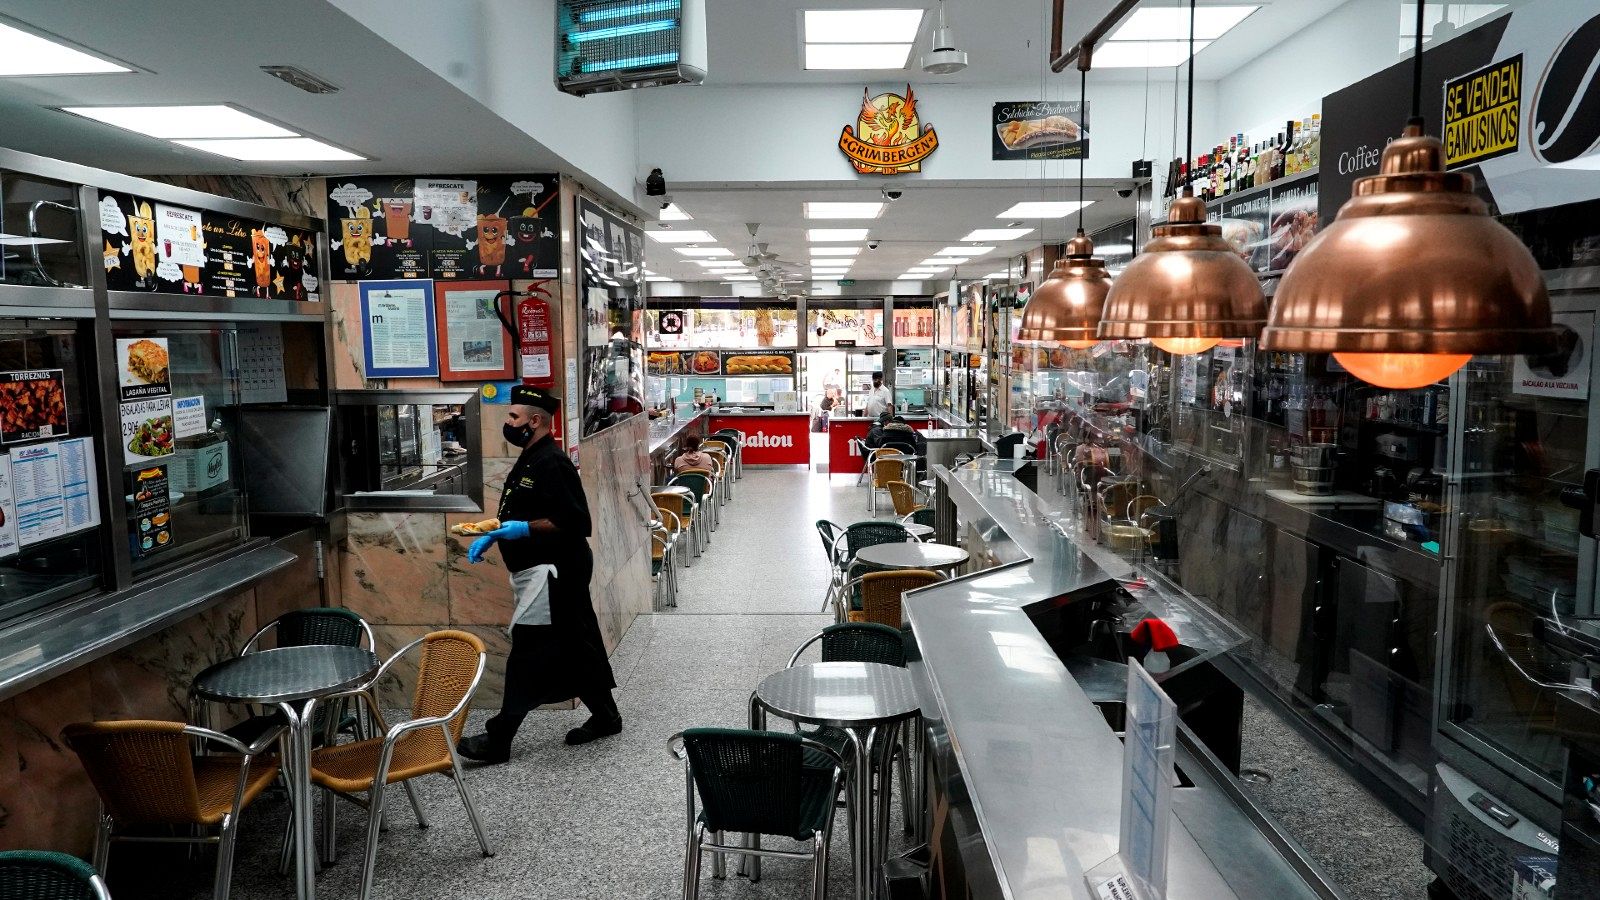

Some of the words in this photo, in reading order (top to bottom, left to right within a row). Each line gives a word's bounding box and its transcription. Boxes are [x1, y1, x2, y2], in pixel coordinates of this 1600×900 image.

[1446, 84, 1463, 123] SE
[1466, 61, 1520, 115] VENDEN
[1446, 104, 1518, 161] GAMUSINOS
[847, 140, 931, 162] GRIMBERGEN
[1338, 144, 1380, 175] Coffee
[10, 371, 51, 381] TORREZNOS
